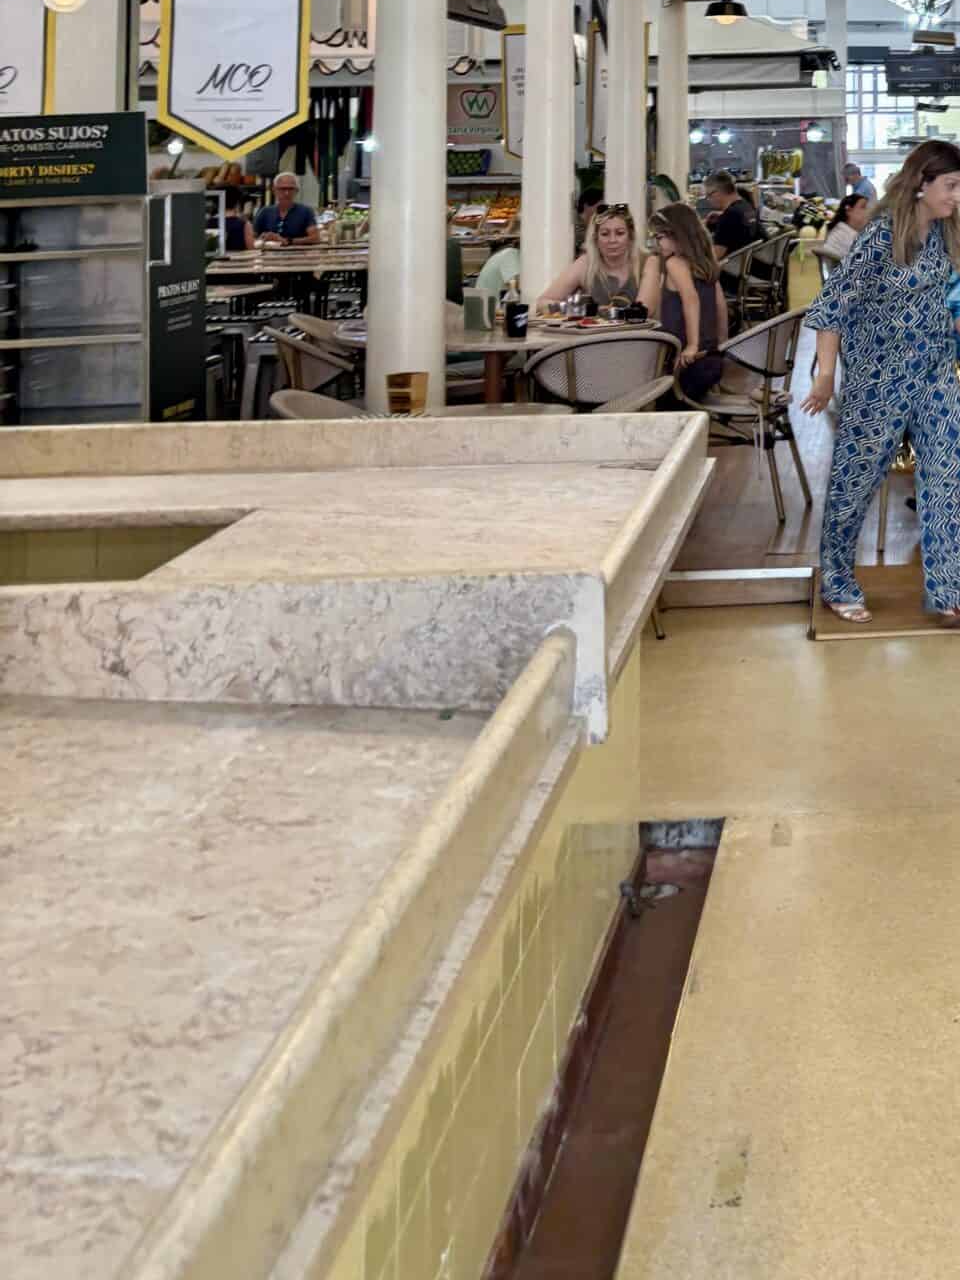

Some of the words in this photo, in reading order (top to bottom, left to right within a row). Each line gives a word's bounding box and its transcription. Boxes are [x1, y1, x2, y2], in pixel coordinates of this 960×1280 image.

[195, 63, 273, 95] MCO
[0, 127, 46, 142] ATOS
[48, 124, 109, 141] SUJOS?
[38, 163, 96, 176] DISHES?
